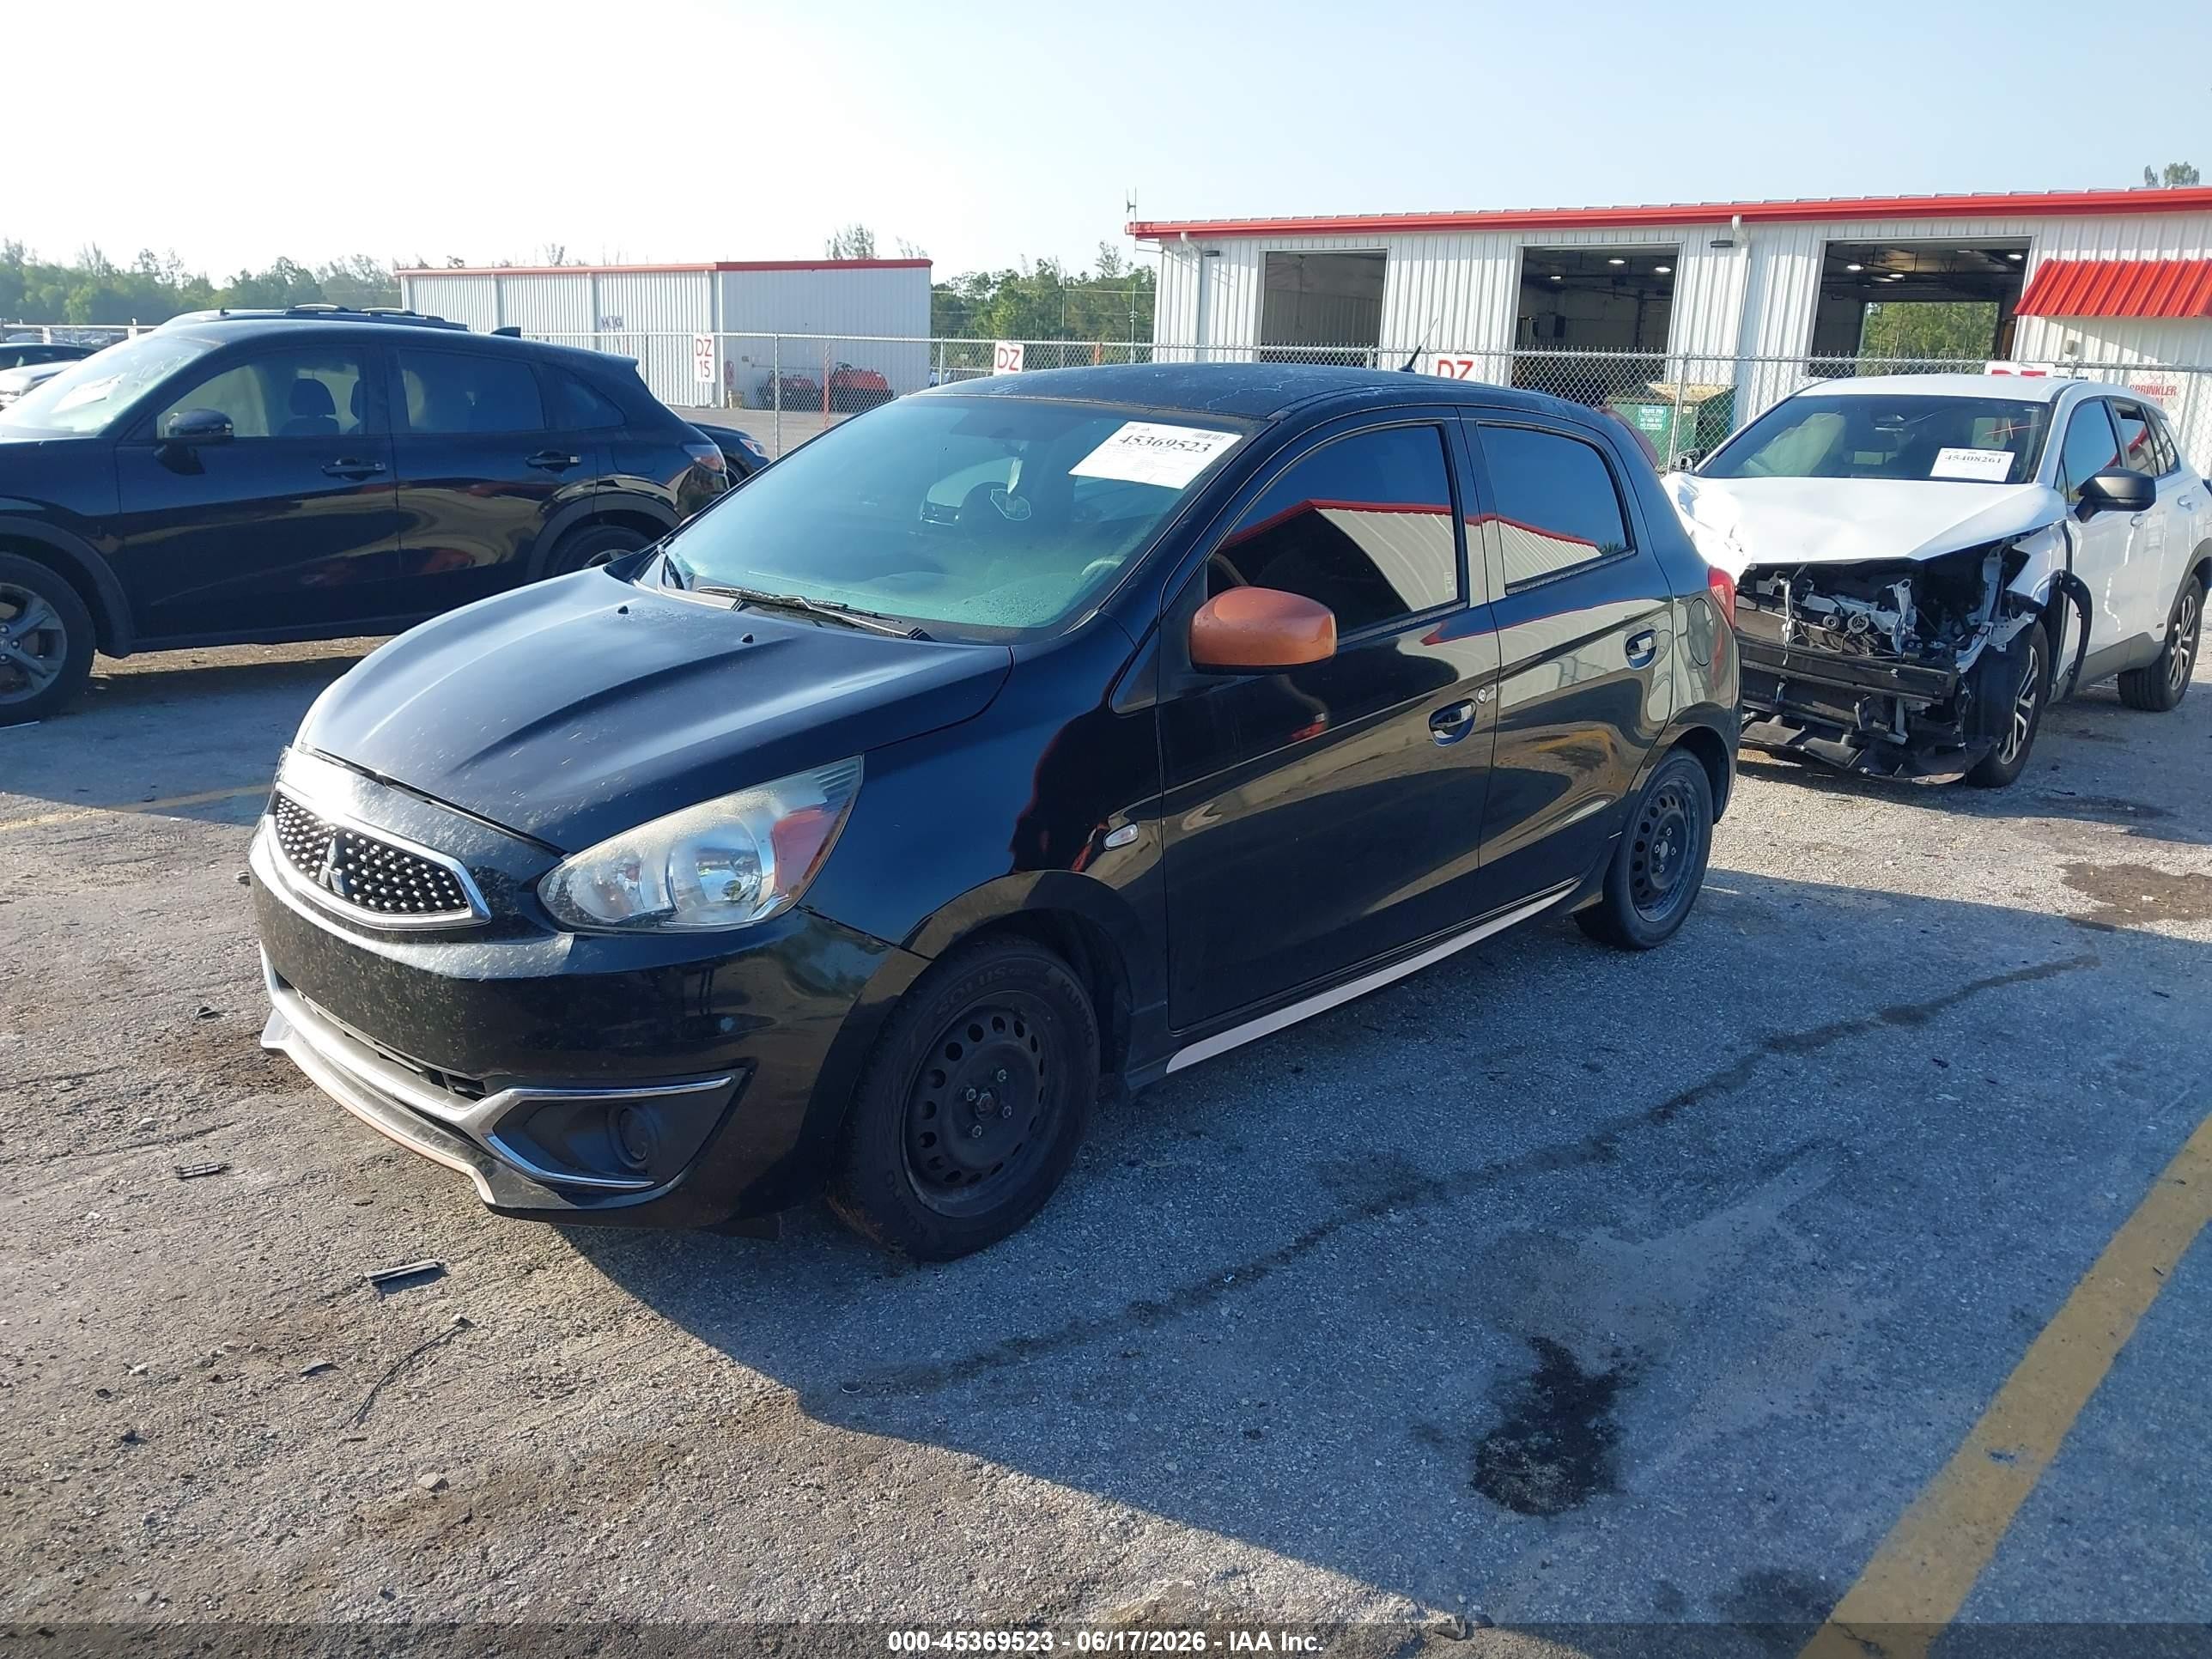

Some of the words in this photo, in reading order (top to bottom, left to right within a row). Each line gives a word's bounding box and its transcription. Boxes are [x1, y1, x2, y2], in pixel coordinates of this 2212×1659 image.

[696, 338, 712, 356] DZ
[998, 347, 1020, 371] DZ
[700, 361, 710, 378] 15
[1119, 434, 1212, 453] 45369523
